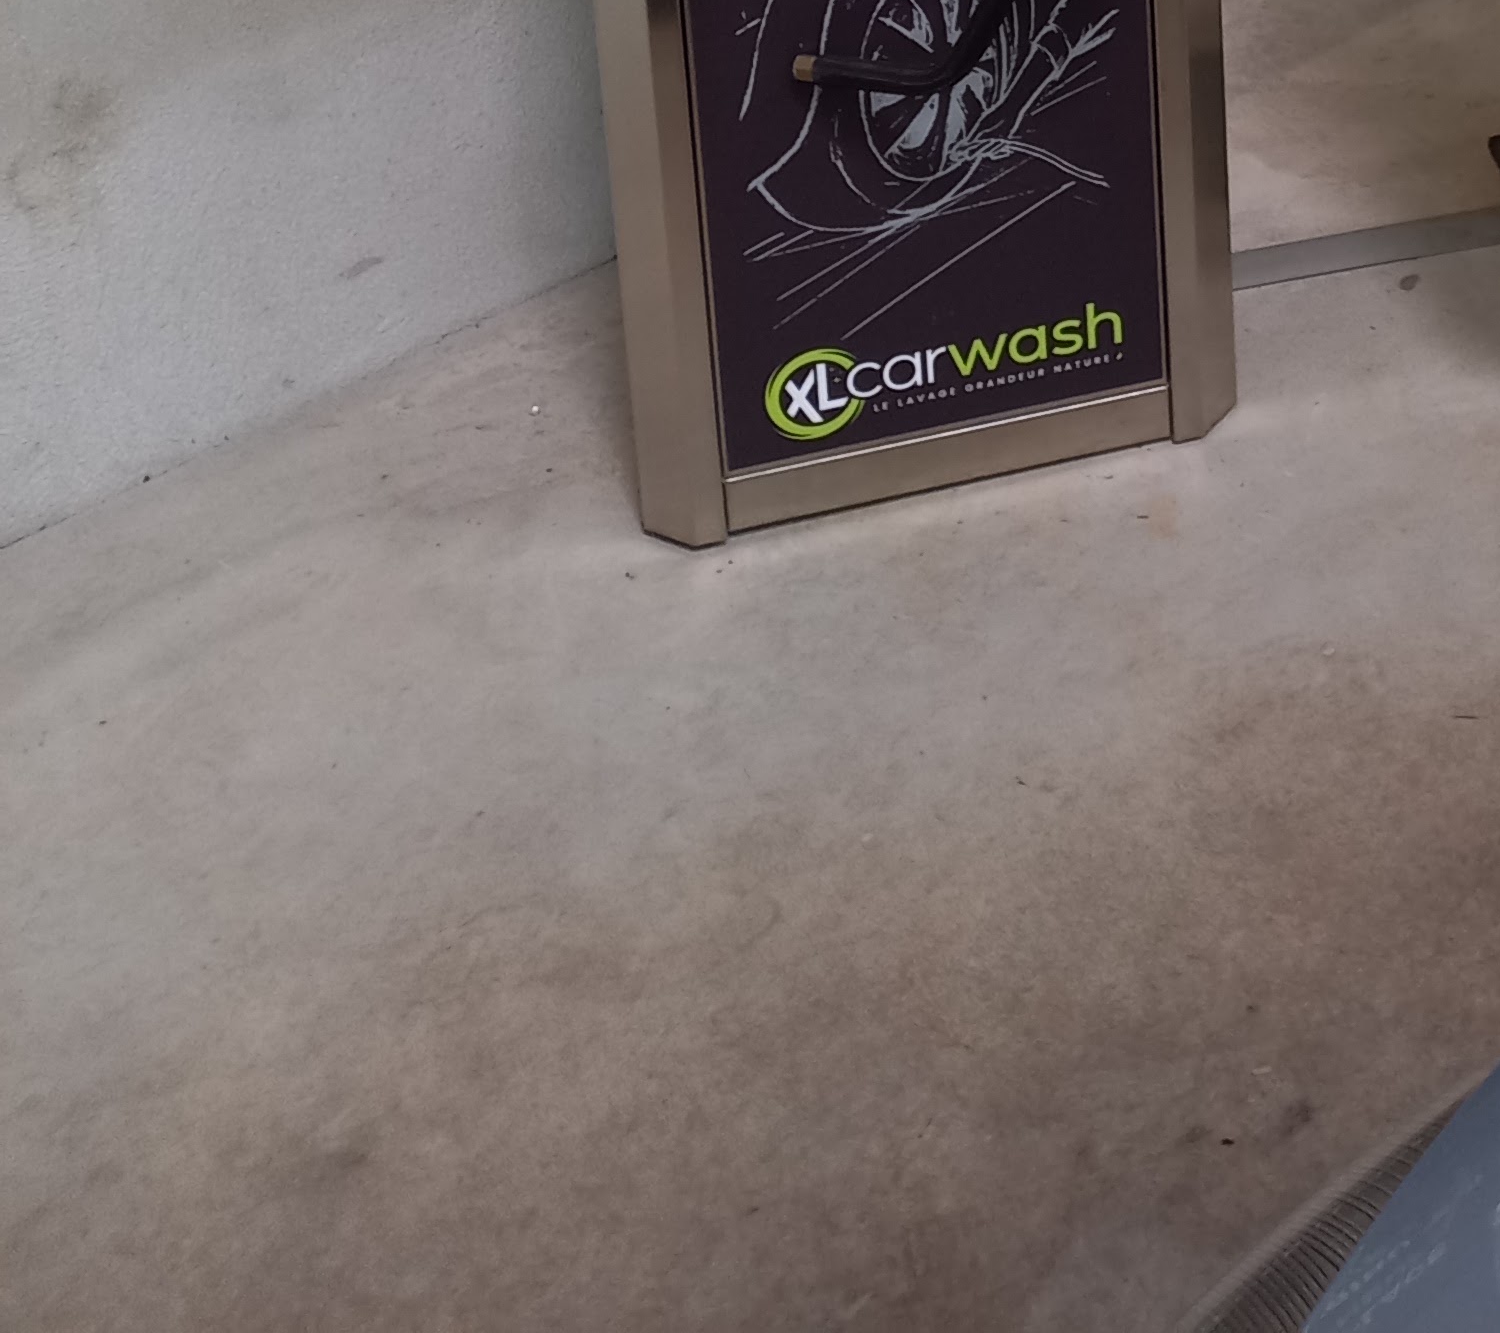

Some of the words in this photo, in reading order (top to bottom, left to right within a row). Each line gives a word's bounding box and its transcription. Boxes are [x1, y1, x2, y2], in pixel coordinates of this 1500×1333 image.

[873, 401, 889, 412] LE
[897, 387, 956, 408] LAVAGE
[964, 368, 1046, 393] GRANDEUR
[1053, 353, 1111, 374] NATURE
